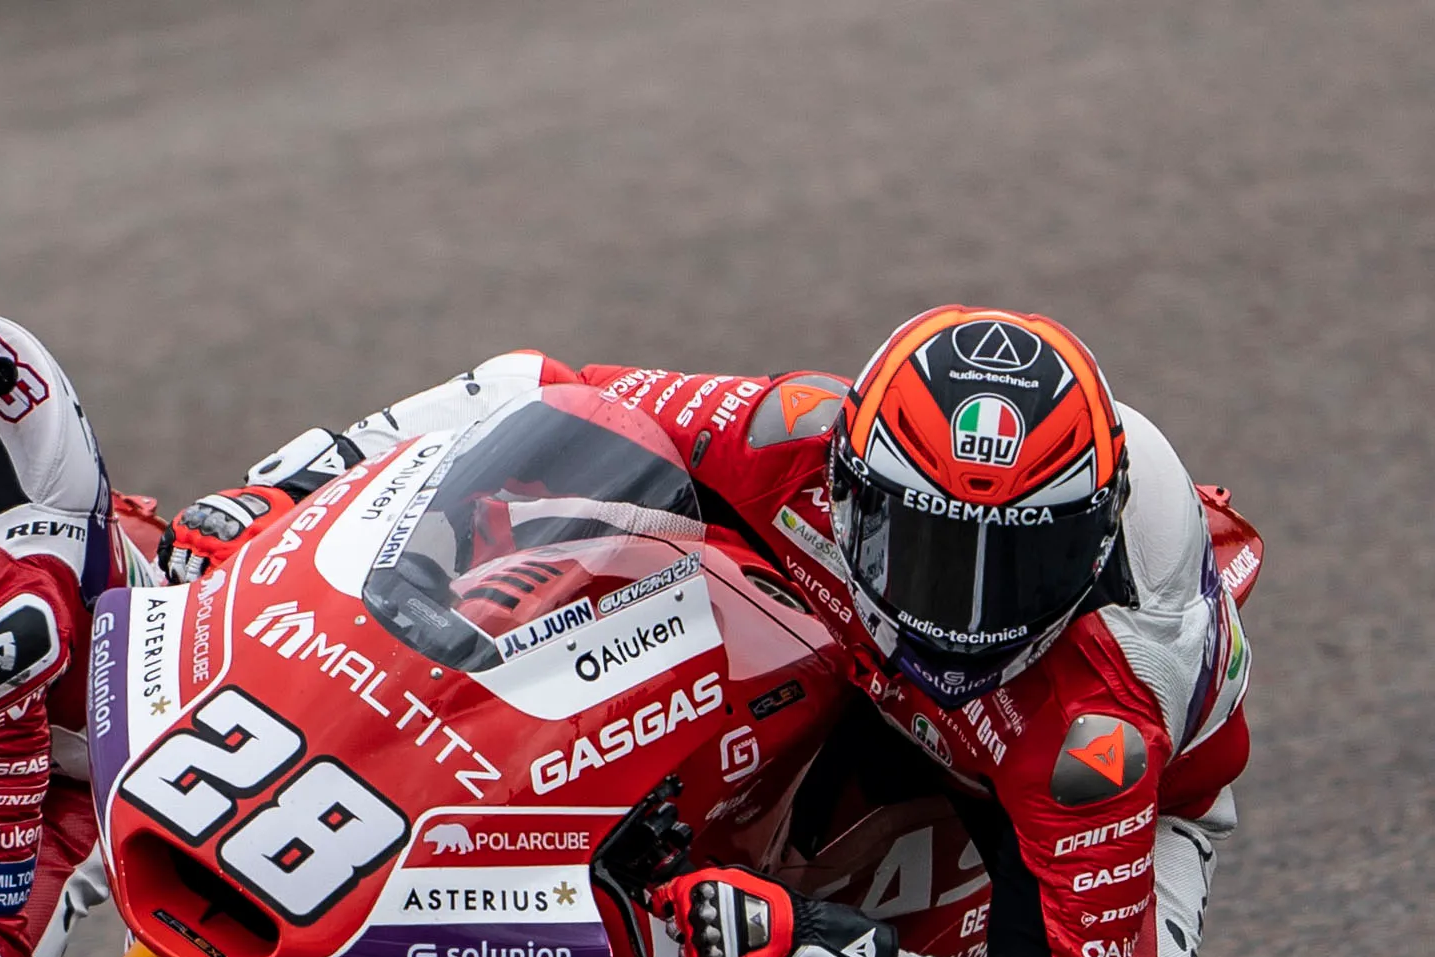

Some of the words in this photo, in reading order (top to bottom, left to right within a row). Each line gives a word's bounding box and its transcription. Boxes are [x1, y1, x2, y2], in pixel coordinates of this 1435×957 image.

[948, 369, 1040, 389] audio-technica
[959, 434, 1014, 464] agv
[902, 487, 1055, 526] ESDEMARCA
[142, 598, 167, 698] ASTERIUS
[191, 597, 217, 685] POLARCUBE
[528, 601, 593, 647] J.JUAN
[602, 615, 686, 673] Aiuken
[897, 609, 1028, 644] audio-technica
[94, 639, 116, 738] solunion
[913, 662, 999, 696] solunion
[299, 632, 502, 801] MALTITZ
[530, 672, 724, 796] GASGAS
[118, 684, 412, 928] 28
[1053, 803, 1156, 857] DAINESE
[475, 831, 590, 851] POLARCUBE
[403, 888, 549, 912] ASTERIUS
